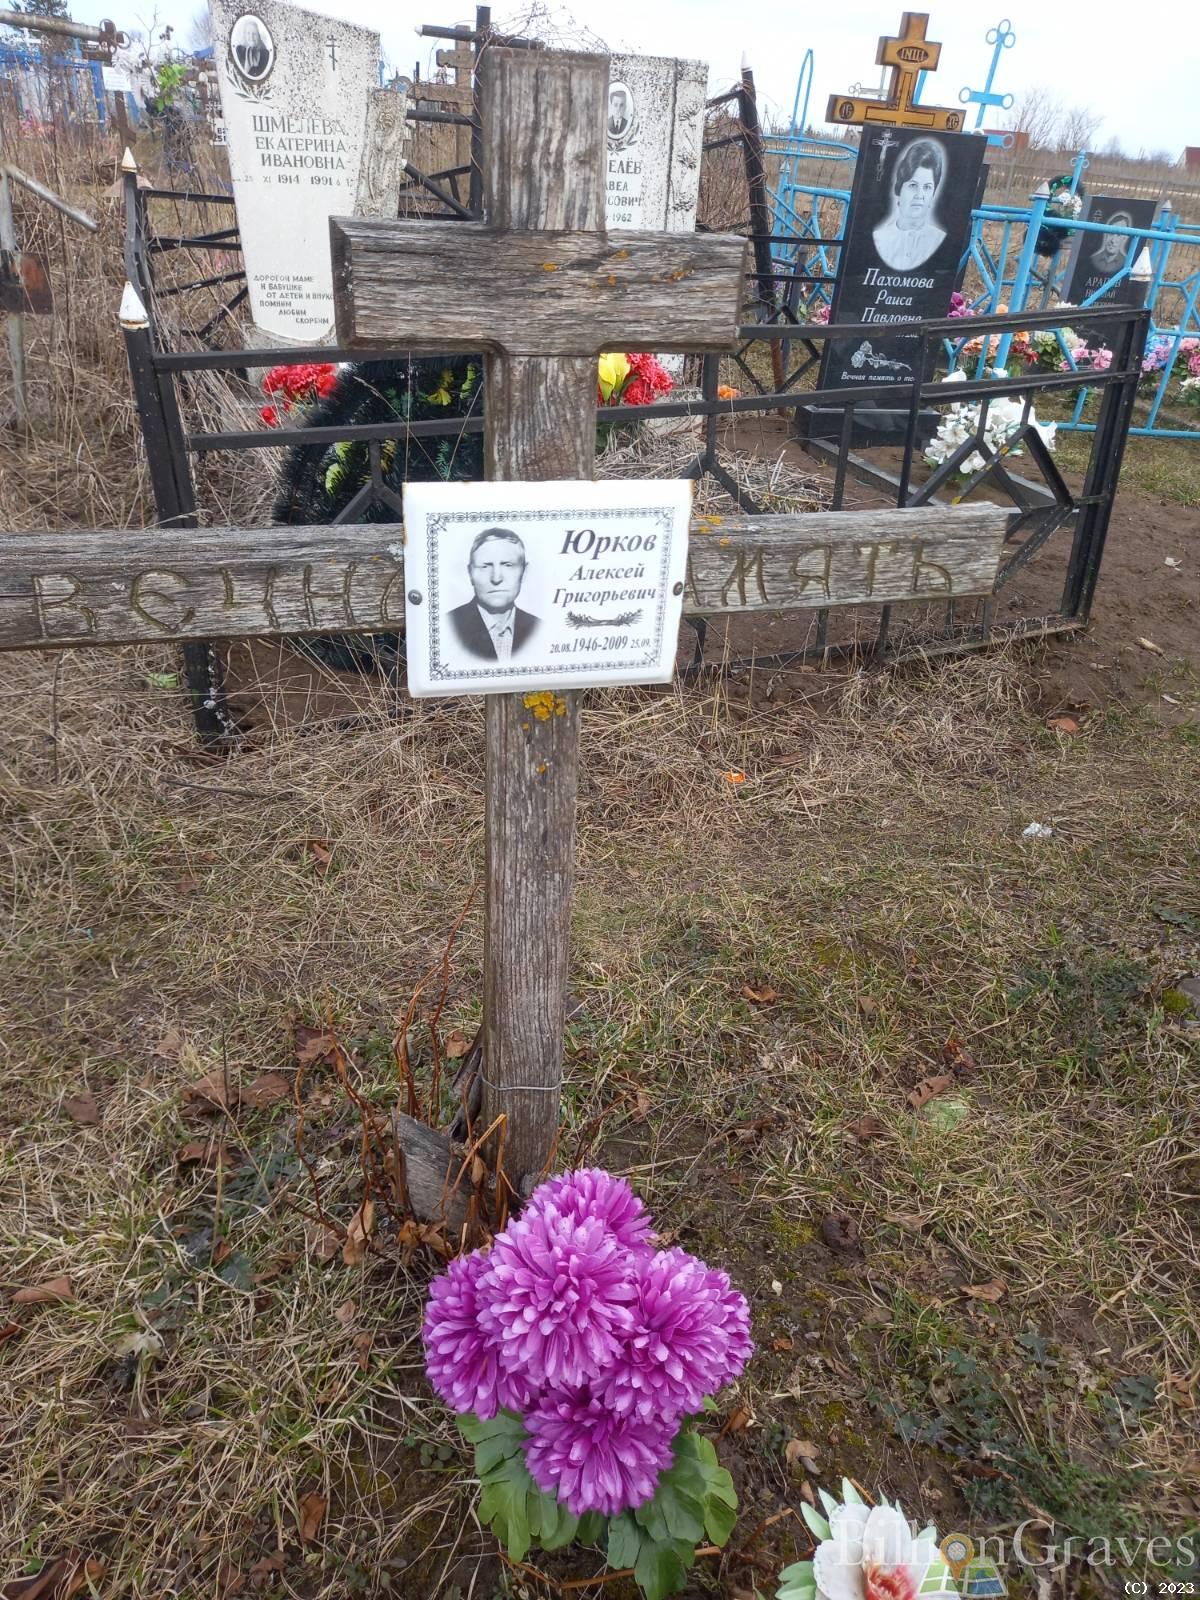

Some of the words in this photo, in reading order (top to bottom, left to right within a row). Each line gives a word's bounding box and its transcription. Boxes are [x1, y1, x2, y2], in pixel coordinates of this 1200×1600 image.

[255, 137, 347, 153] ЕКАТЕРИНА
[261, 153, 345, 169] ИВАНОВНА
[608, 157, 642, 174] ЕЛЁВ
[278, 174, 301, 185] 1914
[310, 175, 333, 186] 1991
[607, 195, 641, 206] СОВИЧ
[612, 213, 632, 222] 1962
[862, 267, 936, 289] Пахомова
[268, 283, 303, 291] БАБУШКЕ
[874, 289, 913, 306] Раиса
[295, 317, 329, 325] СКОРБИМ
[558, 529, 657, 560] Юрков
[568, 562, 645, 581] Алексей
[552, 587, 657, 608] Григорьевич
